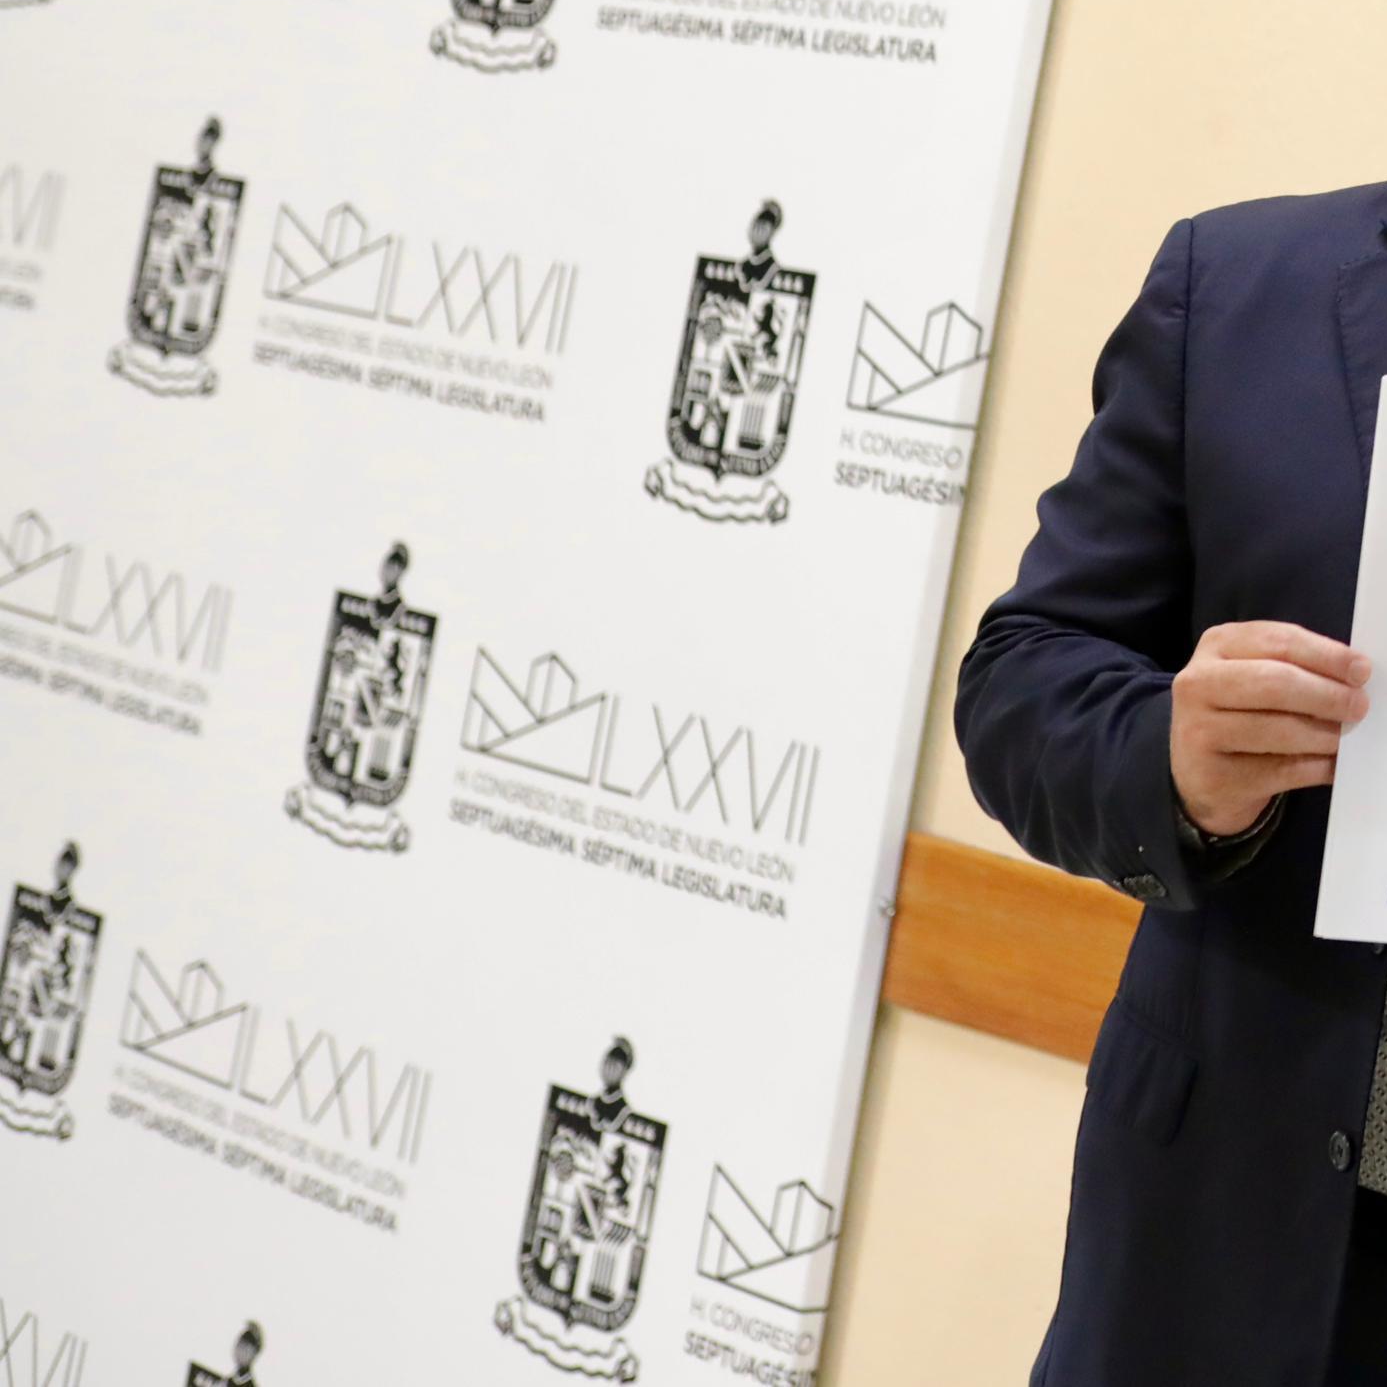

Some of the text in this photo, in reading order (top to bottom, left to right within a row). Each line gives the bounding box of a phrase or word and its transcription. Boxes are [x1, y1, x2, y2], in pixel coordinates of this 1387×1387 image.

[597, 5, 937, 63] SEPTUAGÉSIMA SÉPTIMA LEGISLATURA
[385, 234, 579, 355] LXXVII
[600, 692, 821, 848] LXXVII
[449, 798, 787, 921] SEPTUAGÉSIMA SÉPTIMA LEGISLATURA
